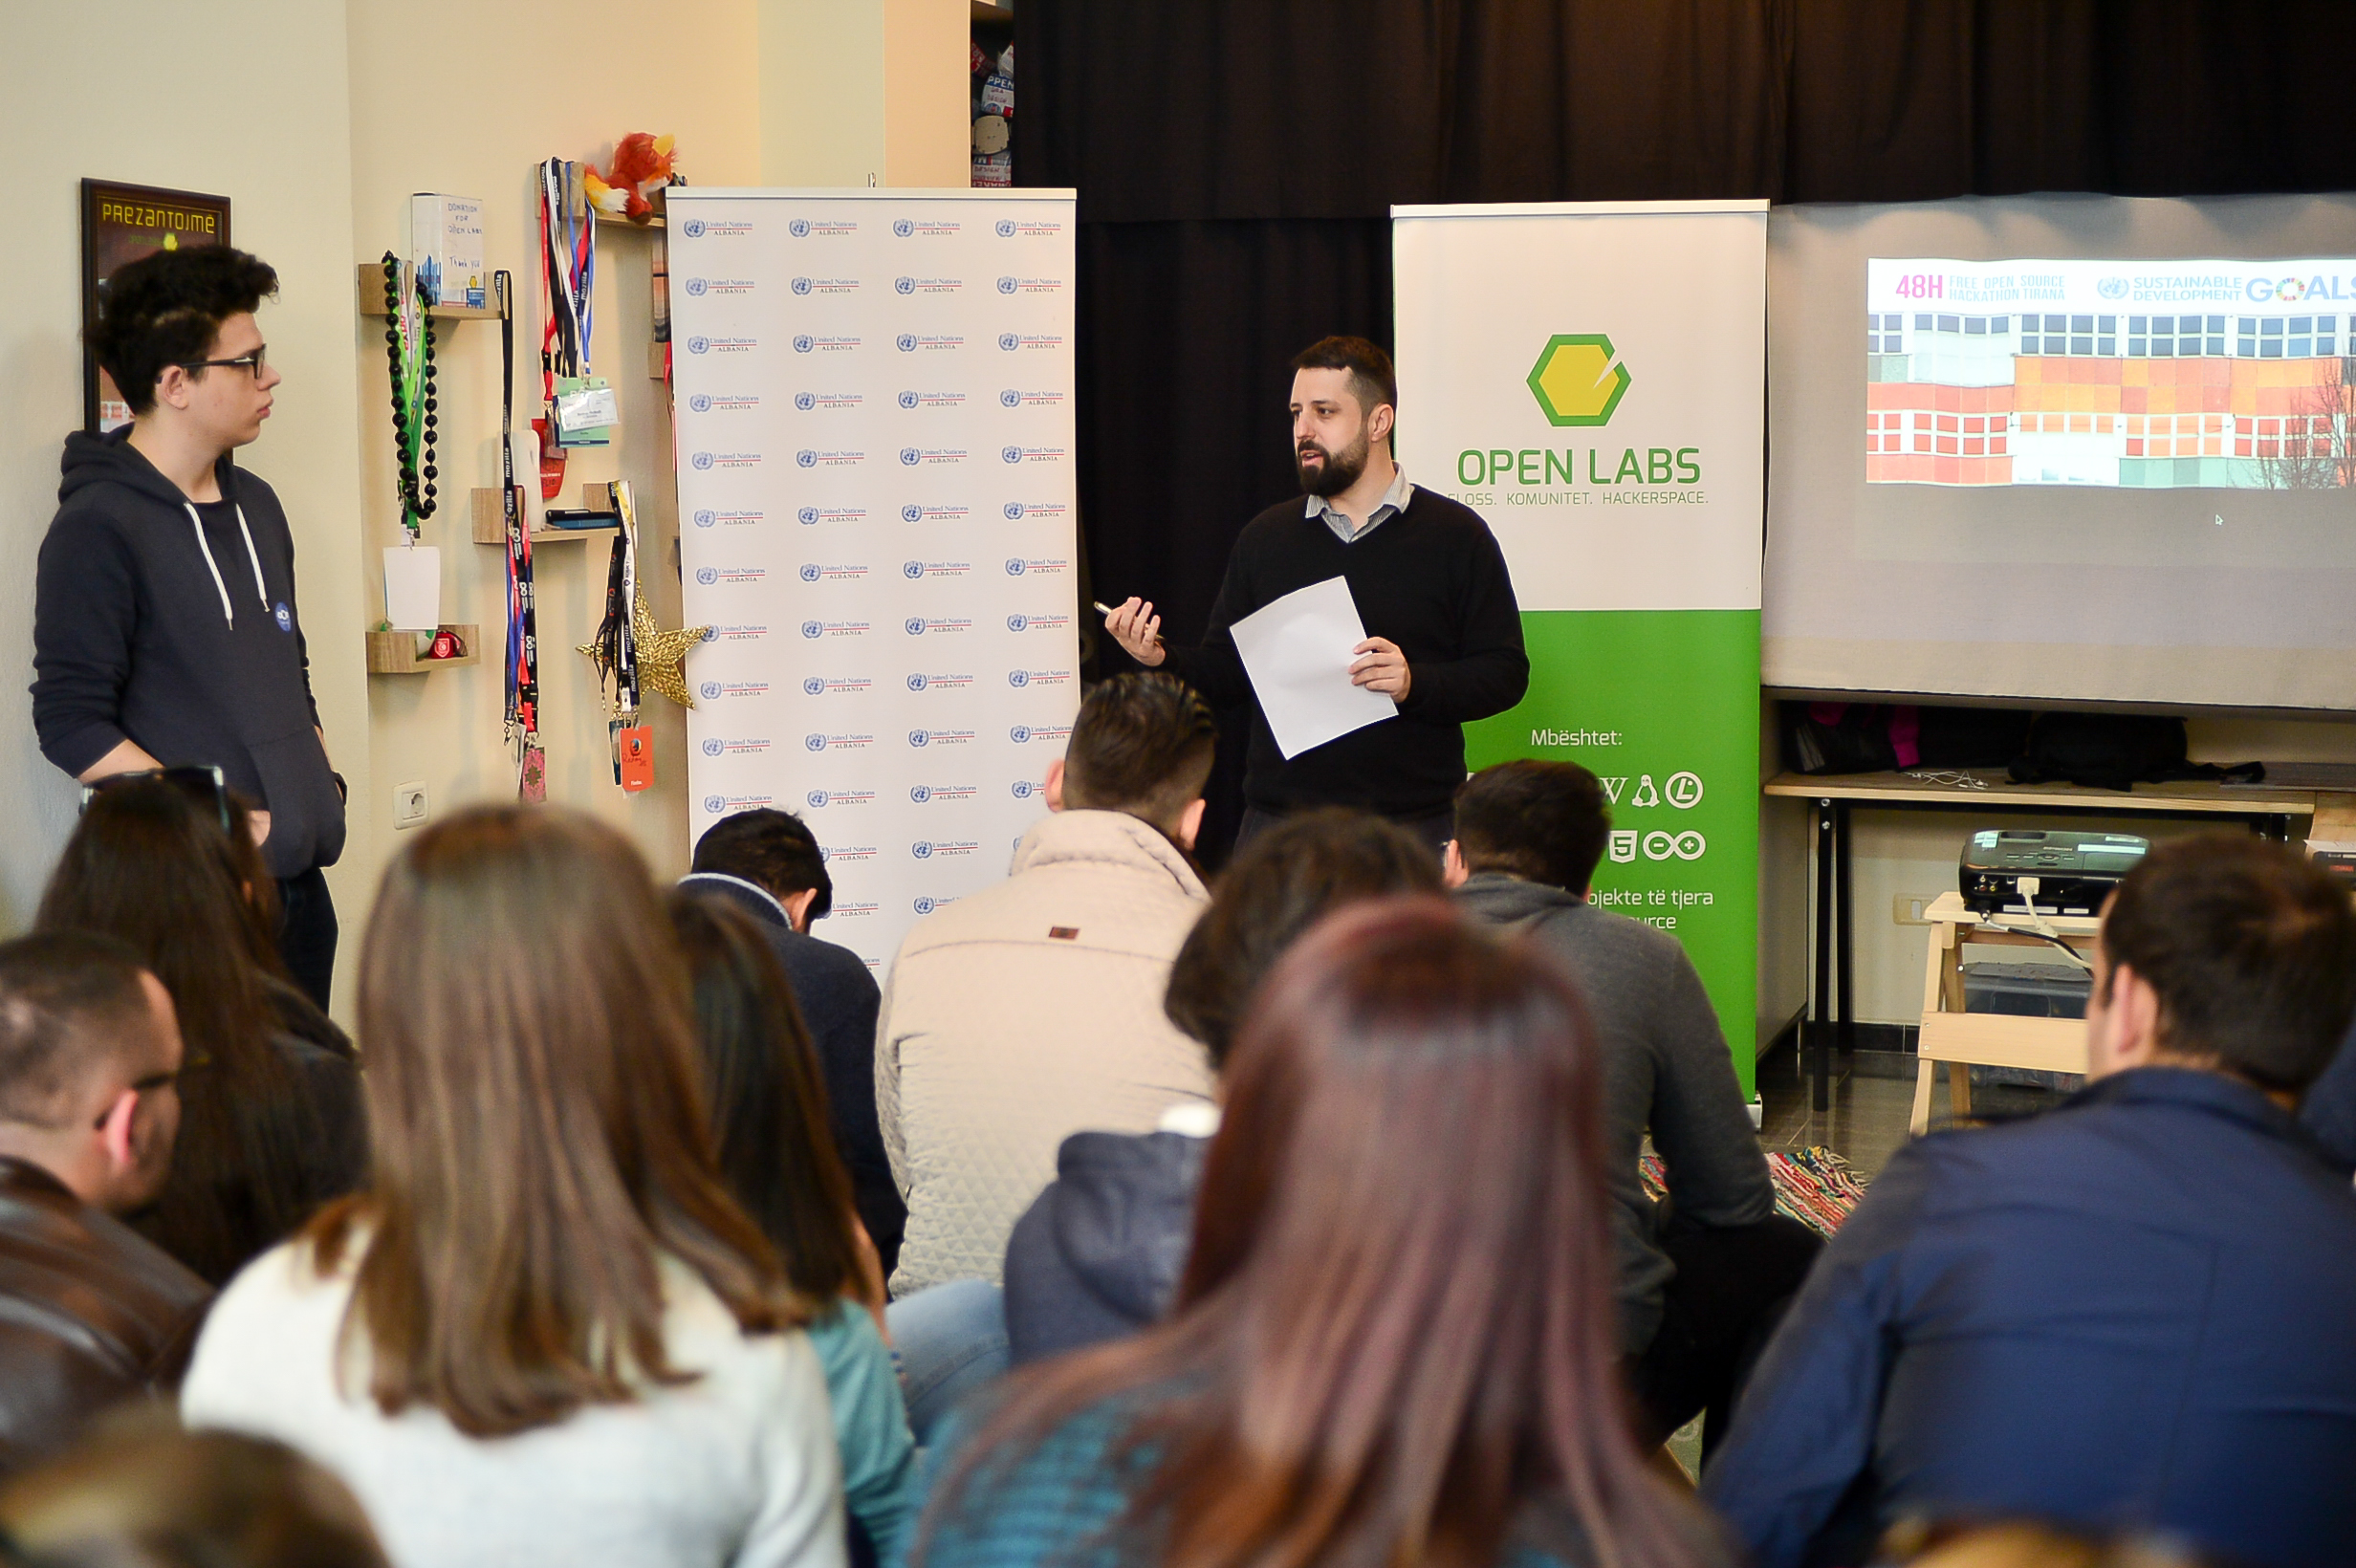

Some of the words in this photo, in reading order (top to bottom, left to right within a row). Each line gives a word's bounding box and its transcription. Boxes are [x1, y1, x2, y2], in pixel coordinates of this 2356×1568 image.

[1895, 274, 1943, 298] 48H
[1949, 275, 1978, 290] FREE
[1984, 275, 2015, 289] OPEN
[2020, 274, 2065, 287] SOURCE
[2133, 275, 2242, 289] SUSTAINABLE
[2246, 275, 2356, 302] GOAL
[1949, 288, 2019, 302] HACKATHON
[2023, 288, 2065, 301] TIRANA
[2133, 290, 2240, 301] DEVELOPMENT
[1457, 448, 1573, 485] OPEN
[1589, 447, 1701, 485] LABS
[1506, 491, 1593, 506] KOMUNITET.
[1603, 490, 1709, 505] HACKERSPACE.
[628, 664, 637, 692] mozilla
[1051, 724, 1072, 732] Nations
[725, 738, 746, 747] United
[849, 732, 874, 741] Nations
[1531, 729, 1623, 746] Mbështet:
[853, 844, 877, 853] Nations
[1587, 888, 1643, 910] ojekte
[1647, 889, 1666, 905] të
[1670, 889, 1714, 910] tjera
